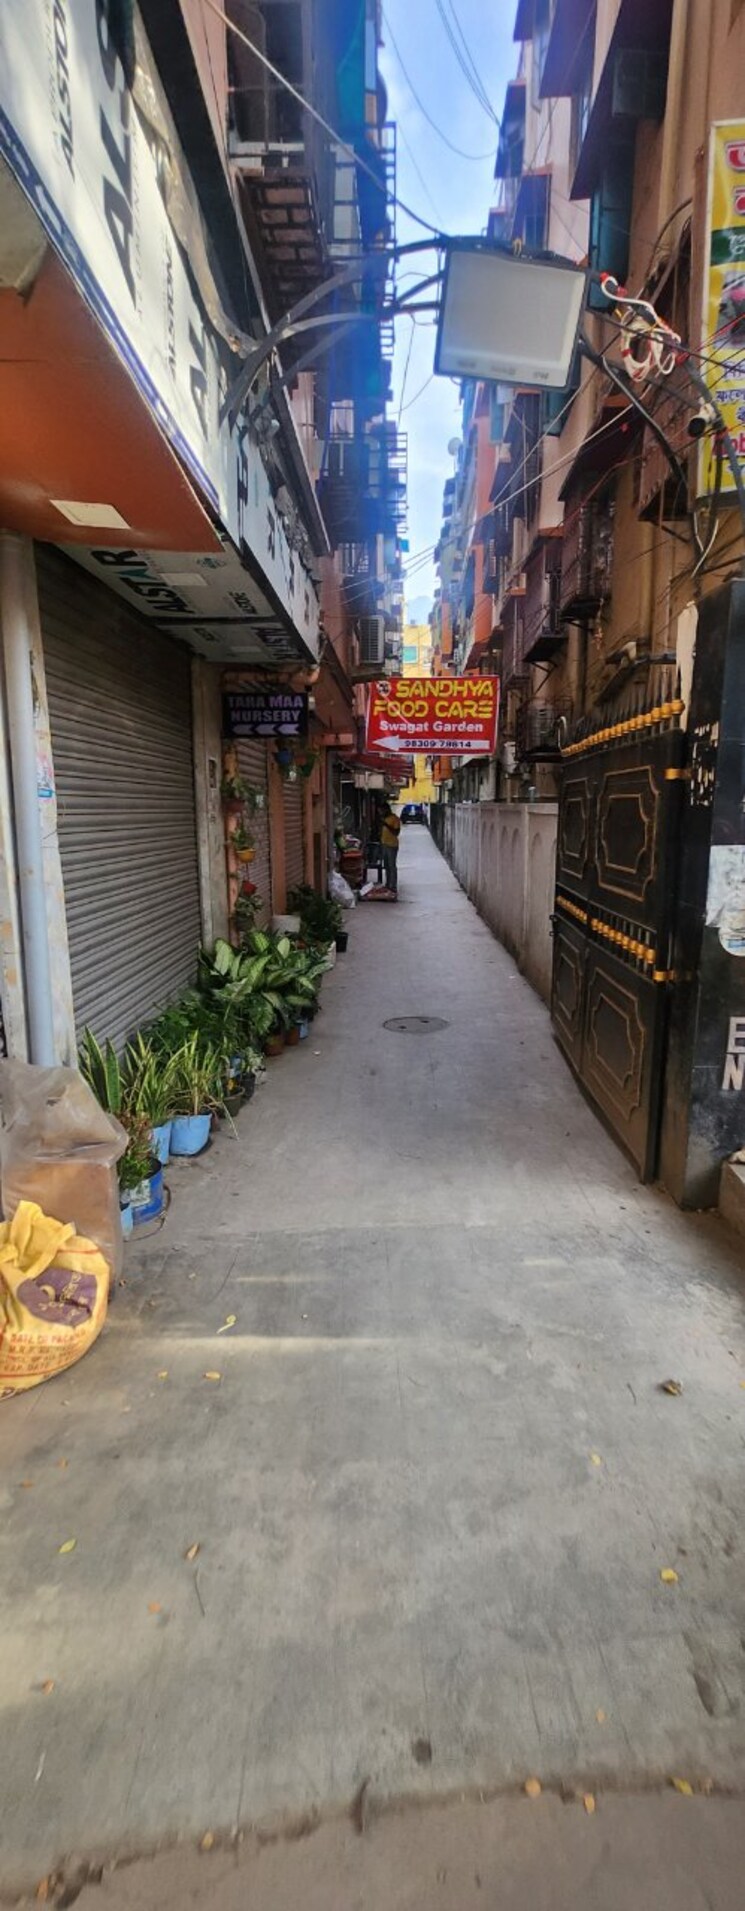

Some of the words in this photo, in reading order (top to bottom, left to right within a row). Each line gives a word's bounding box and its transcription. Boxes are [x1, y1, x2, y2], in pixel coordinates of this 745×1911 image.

[395, 680, 494, 698] SANDHYA
[228, 695, 266, 708] TARA
[268, 694, 304, 708] MAA
[231, 709, 301, 722] NURSERY
[373, 699, 429, 718] FOOD
[434, 700, 493, 719] CARE
[379, 720, 429, 734] Swagat
[432, 721, 484, 733] Garden
